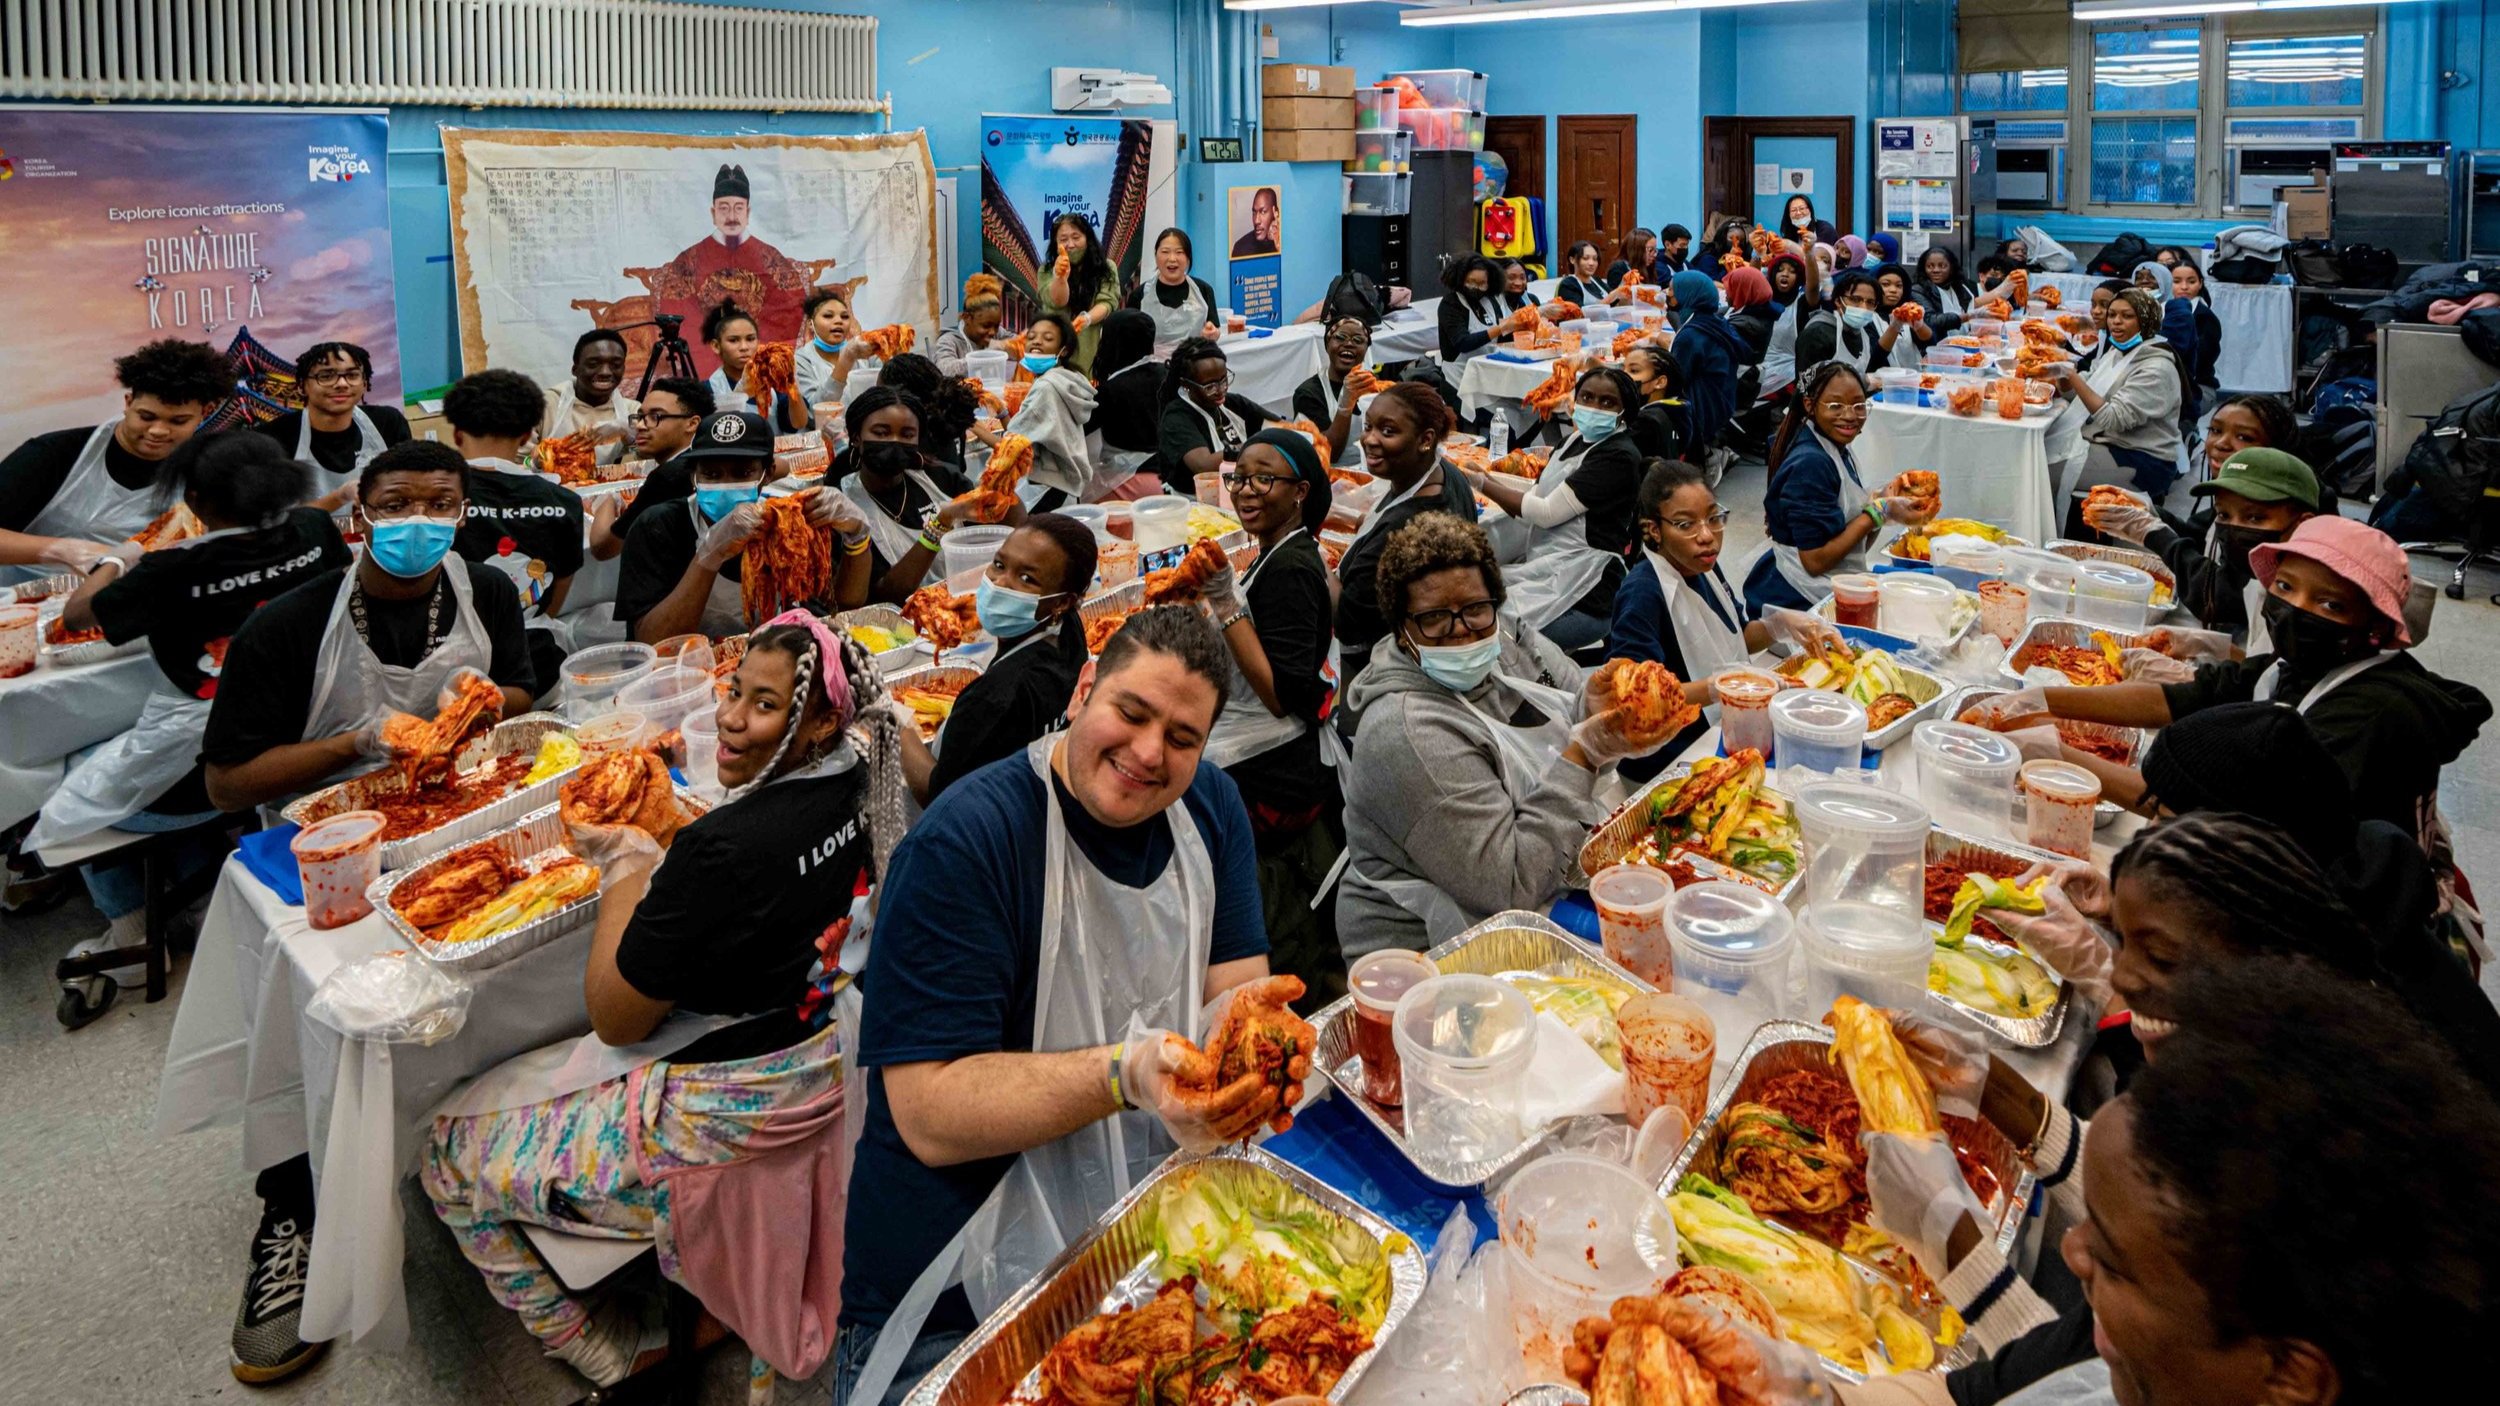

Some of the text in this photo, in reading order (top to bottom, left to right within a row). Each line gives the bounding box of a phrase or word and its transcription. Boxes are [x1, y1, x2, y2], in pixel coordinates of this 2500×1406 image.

[308, 144, 350, 155] Imagine
[335, 152, 358, 162] your
[309, 157, 371, 183] Korea
[1044, 192, 1083, 205] Imagine
[1068, 202, 1091, 213] your
[109, 201, 285, 223] Explore iconic attractions
[145, 231, 261, 276] SIGNATURE
[149, 283, 264, 330] KOREA
[724, 421, 732, 435] B
[467, 506, 566, 519] OVE K-FOOD
[192, 546, 322, 598] I LOVE K-FOOD
[798, 855, 806, 876] I
[812, 818, 857, 868] LOVE
